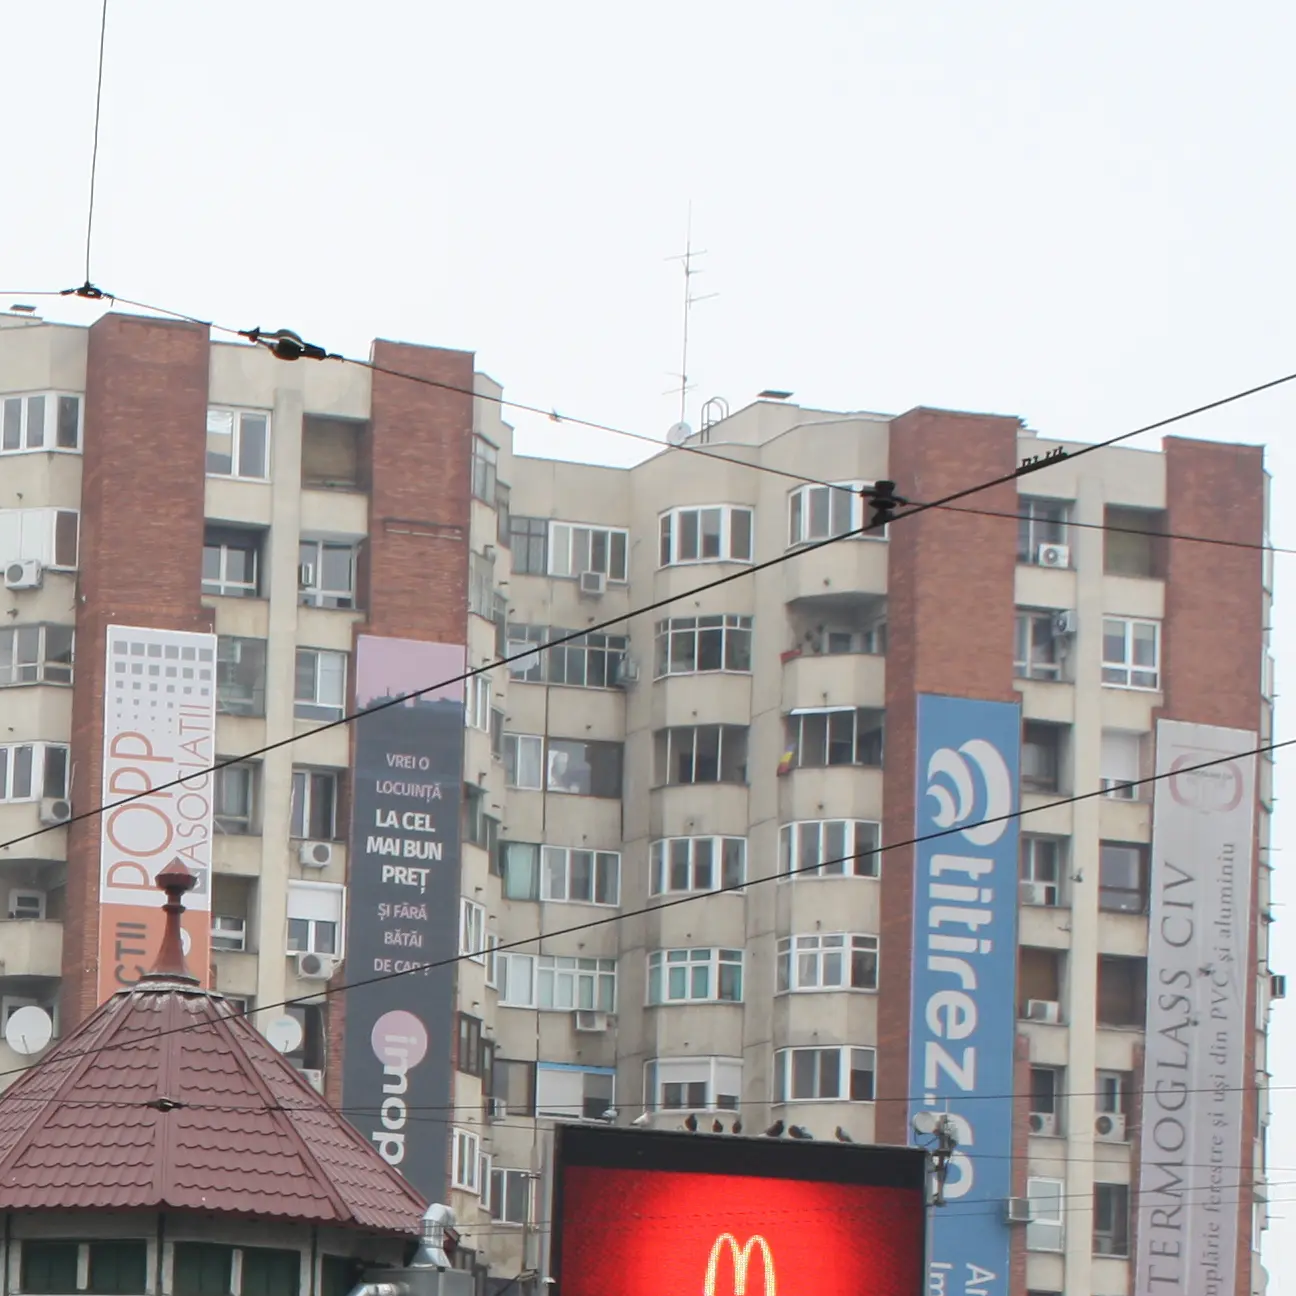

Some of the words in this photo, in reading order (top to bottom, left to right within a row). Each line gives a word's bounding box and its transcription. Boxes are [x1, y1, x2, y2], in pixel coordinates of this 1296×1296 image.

[385, 752, 415, 769] VREI
[417, 756, 430, 771] O
[106, 730, 174, 892] POPP
[375, 779, 442, 804] LOCUINȚĂ
[375, 808, 398, 829] LA
[402, 811, 435, 833] CEL
[366, 835, 399, 856] MAI
[403, 839, 443, 861] BUN
[381, 865, 430, 894] PREȚ
[1214, 842, 1235, 938] aluminiu
[377, 902, 390, 920] ȘI
[1160, 861, 1196, 948] CIV
[115, 922, 146, 987] CTII
[373, 958, 392, 972] DE
[394, 959, 421, 975] CAP
[1211, 967, 1230, 1020] PVC
[1210, 1030, 1228, 1065] din
[372, 1034, 418, 1168] imop
[1147, 968, 1193, 1294] TERMOGLASS
[1203, 1135, 1224, 1213] ferestre
